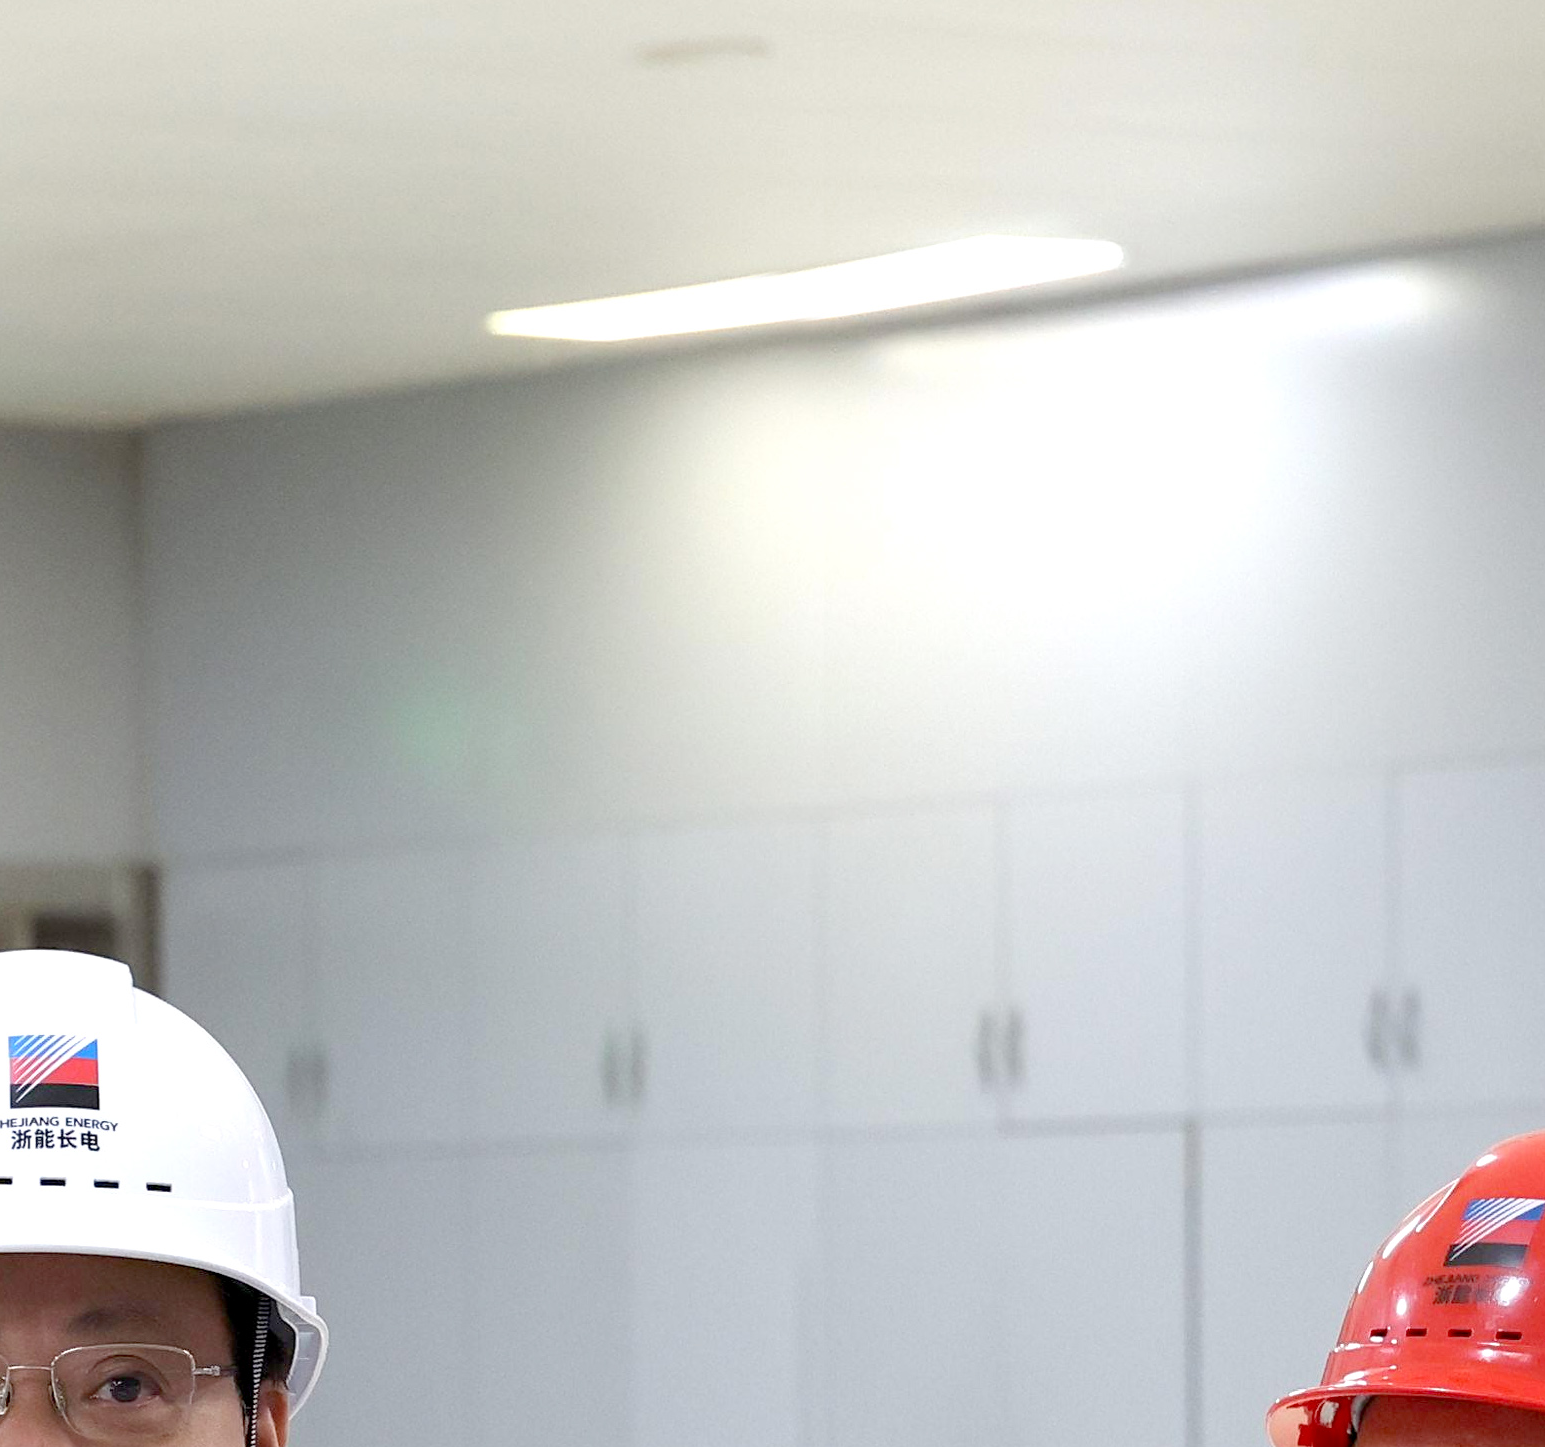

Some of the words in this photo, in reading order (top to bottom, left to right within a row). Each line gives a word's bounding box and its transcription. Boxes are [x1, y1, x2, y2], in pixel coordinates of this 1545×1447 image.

[65, 1117, 118, 1131] ENERGY
[11, 1128, 100, 1151] 浙能长电
